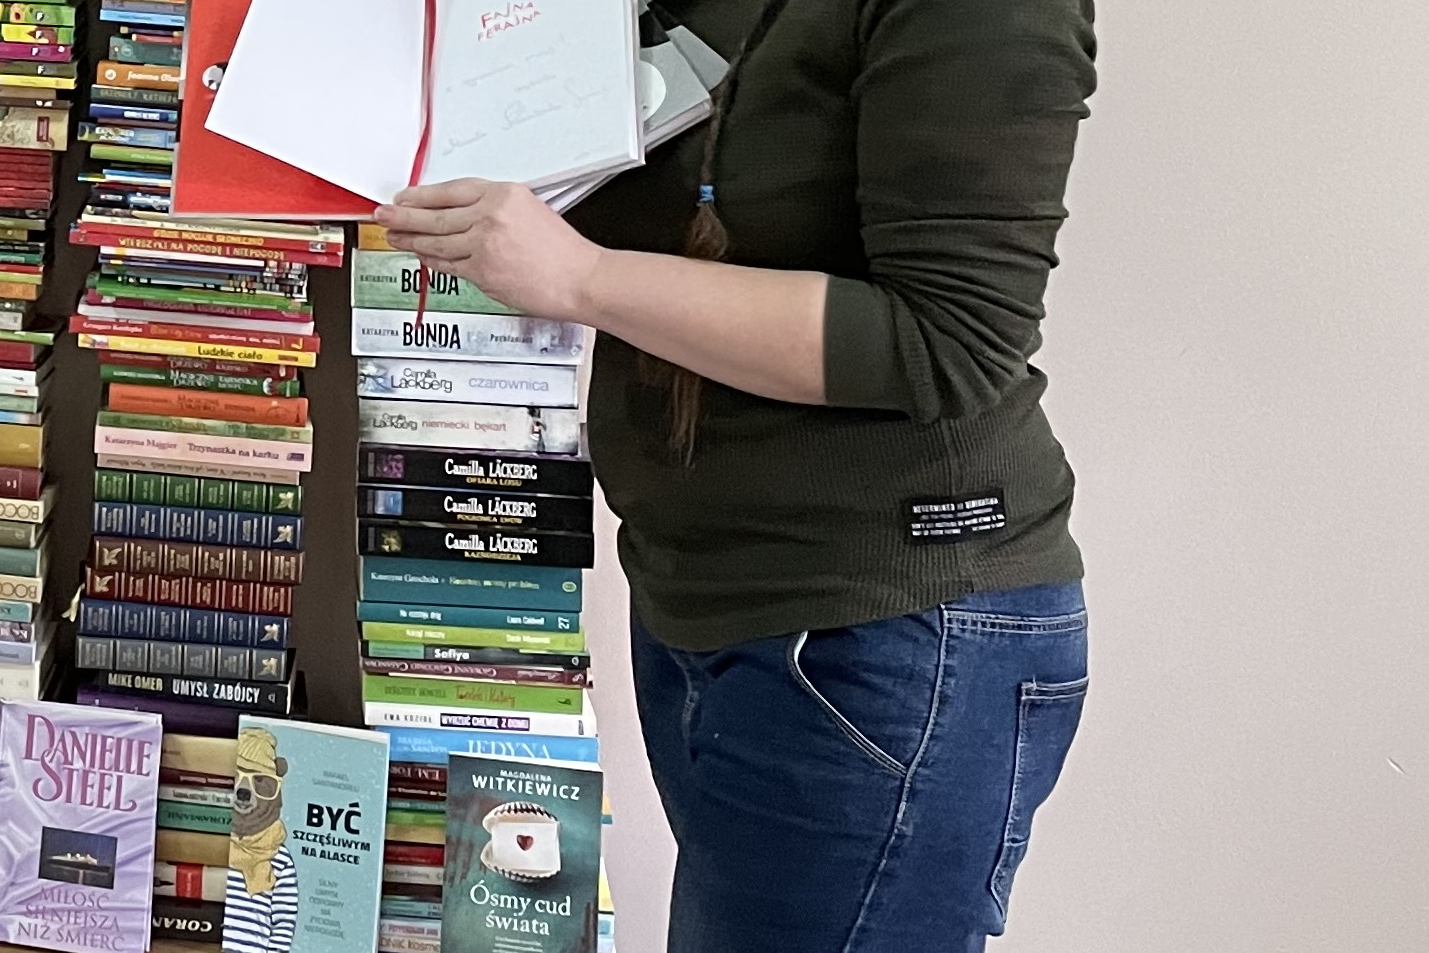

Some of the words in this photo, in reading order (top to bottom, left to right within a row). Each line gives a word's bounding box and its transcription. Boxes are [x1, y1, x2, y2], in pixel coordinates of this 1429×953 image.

[478, 9, 541, 43] FERAJNA
[481, 0, 535, 29] FAJNA
[403, 322, 461, 349] BONDA
[198, 346, 232, 358] Ludzkie
[238, 349, 262, 360] ciało
[468, 376, 549, 392] czarownica
[445, 459, 484, 476] Camilla
[444, 496, 483, 513] Camilla
[445, 533, 485, 551] Camilla
[558, 616, 570, 629] 27
[108, 673, 133, 687] MIKE
[135, 675, 163, 691] OMER
[172, 679, 210, 697] UMYSŁ
[212, 681, 261, 704] ZABÓJCY
[24, 713, 153, 779] DANIELLE
[33, 752, 138, 813] STEEL
[472, 774, 581, 801] WITKIEWICZ
[500, 769, 552, 782] MAGDALENA
[306, 802, 362, 835] BYĆ
[292, 829, 371, 852] SZCZĘŚLIWYM
[302, 845, 318, 857] NA
[320, 848, 360, 866] ALASCE
[40, 885, 110, 911] MIŁOŚĆ
[470, 880, 531, 916] Ósmy
[535, 896, 571, 917] cud
[17, 920, 51, 940] NIŻ
[56, 925, 126, 953] ŚMIERĆ
[485, 912, 551, 936] świata
